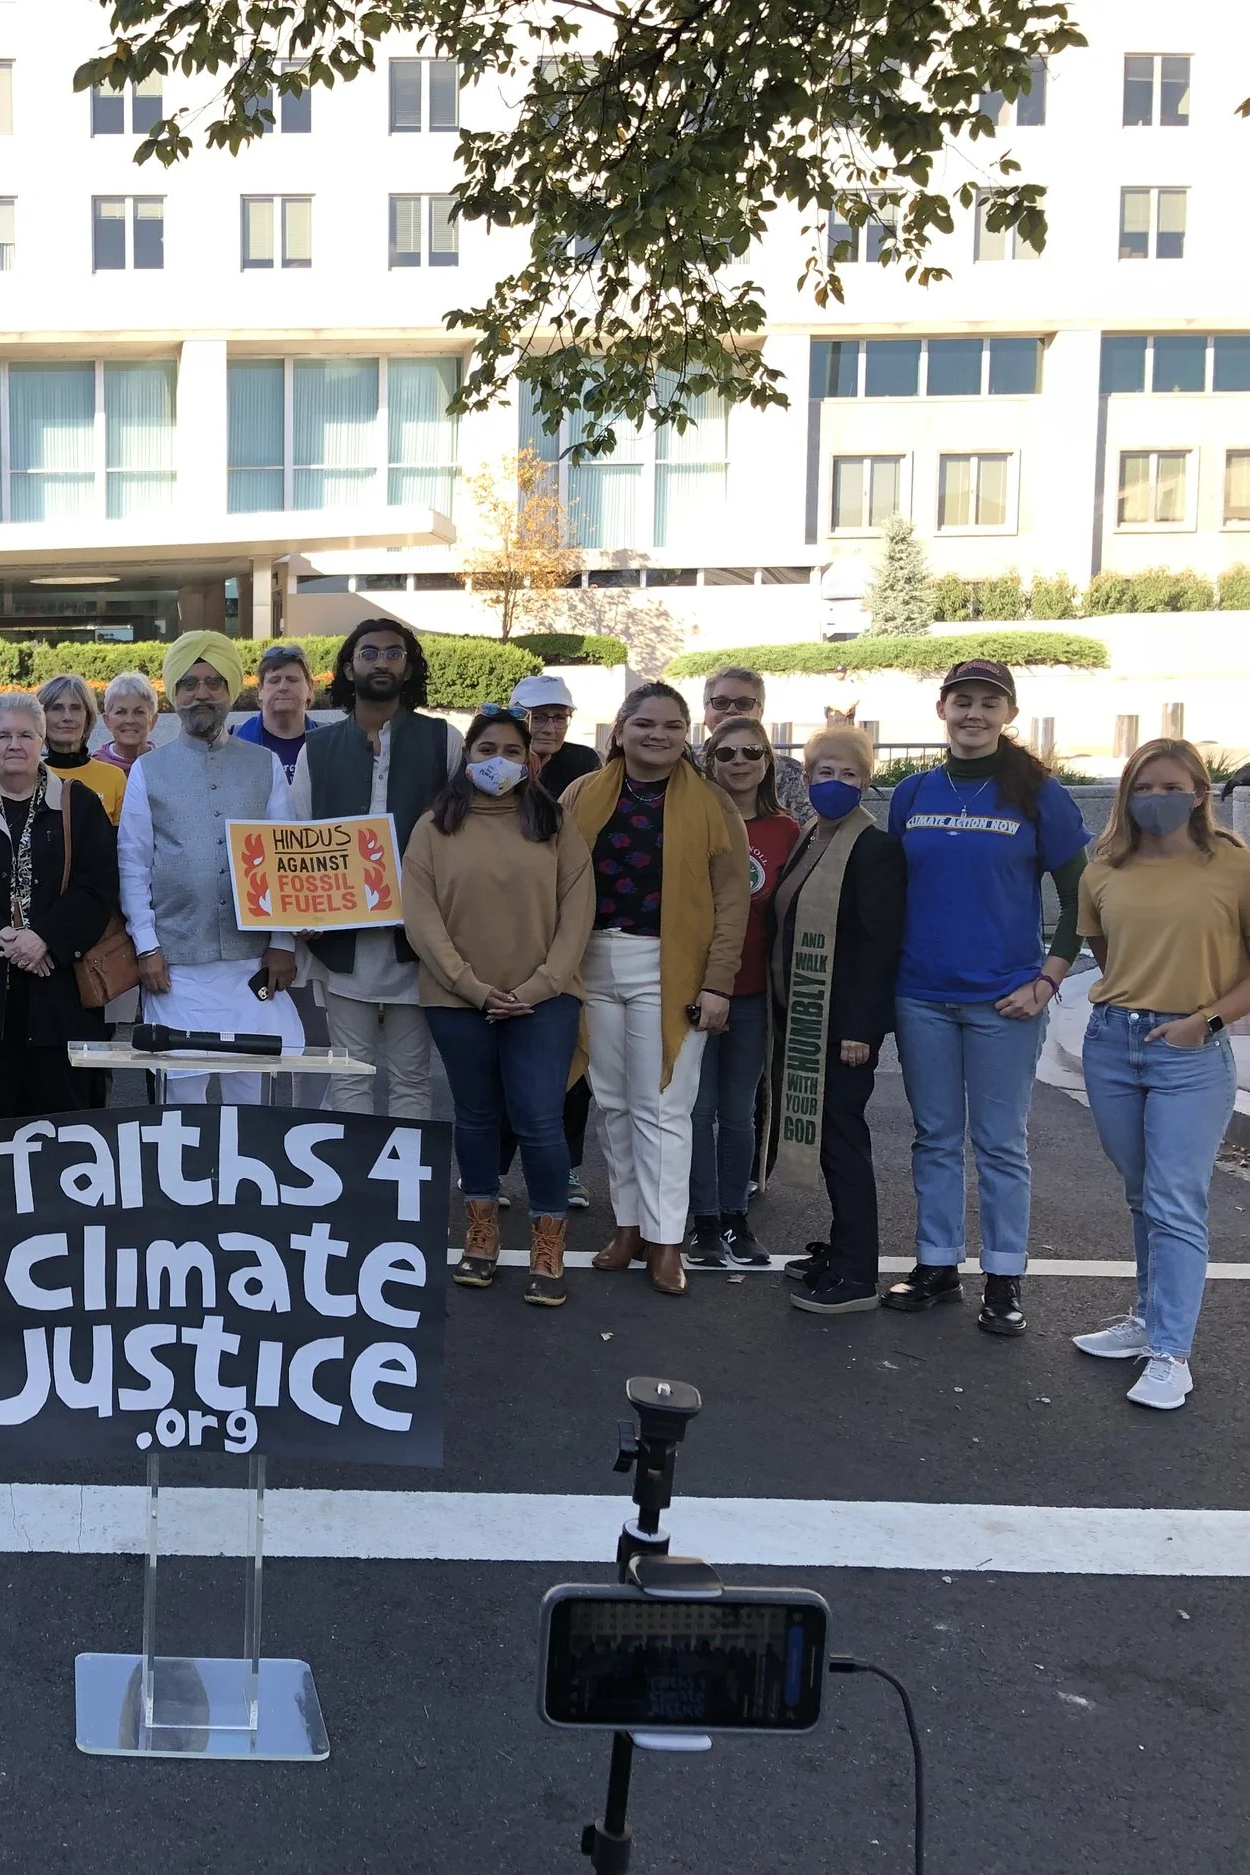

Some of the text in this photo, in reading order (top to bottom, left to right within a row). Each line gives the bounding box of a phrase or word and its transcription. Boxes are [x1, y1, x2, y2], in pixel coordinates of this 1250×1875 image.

[907, 815, 1019, 834] CLIMATE ACTION NOW
[273, 825, 351, 850] HINDUS
[277, 854, 349, 873] AGAINST
[278, 873, 354, 893] FOSSIL
[281, 891, 357, 913] FUELS
[801, 931, 825, 949] AND
[795, 952, 827, 973] WALK
[787, 972, 826, 1073] HUMBLY
[787, 1073, 818, 1095] WITH
[785, 1093, 818, 1116] YOUR
[783, 1115, 816, 1145] GOD
[367, 1127, 432, 1222] 4
[4, 1222, 426, 1328] climate
[136, 1408, 258, 1454] .org
